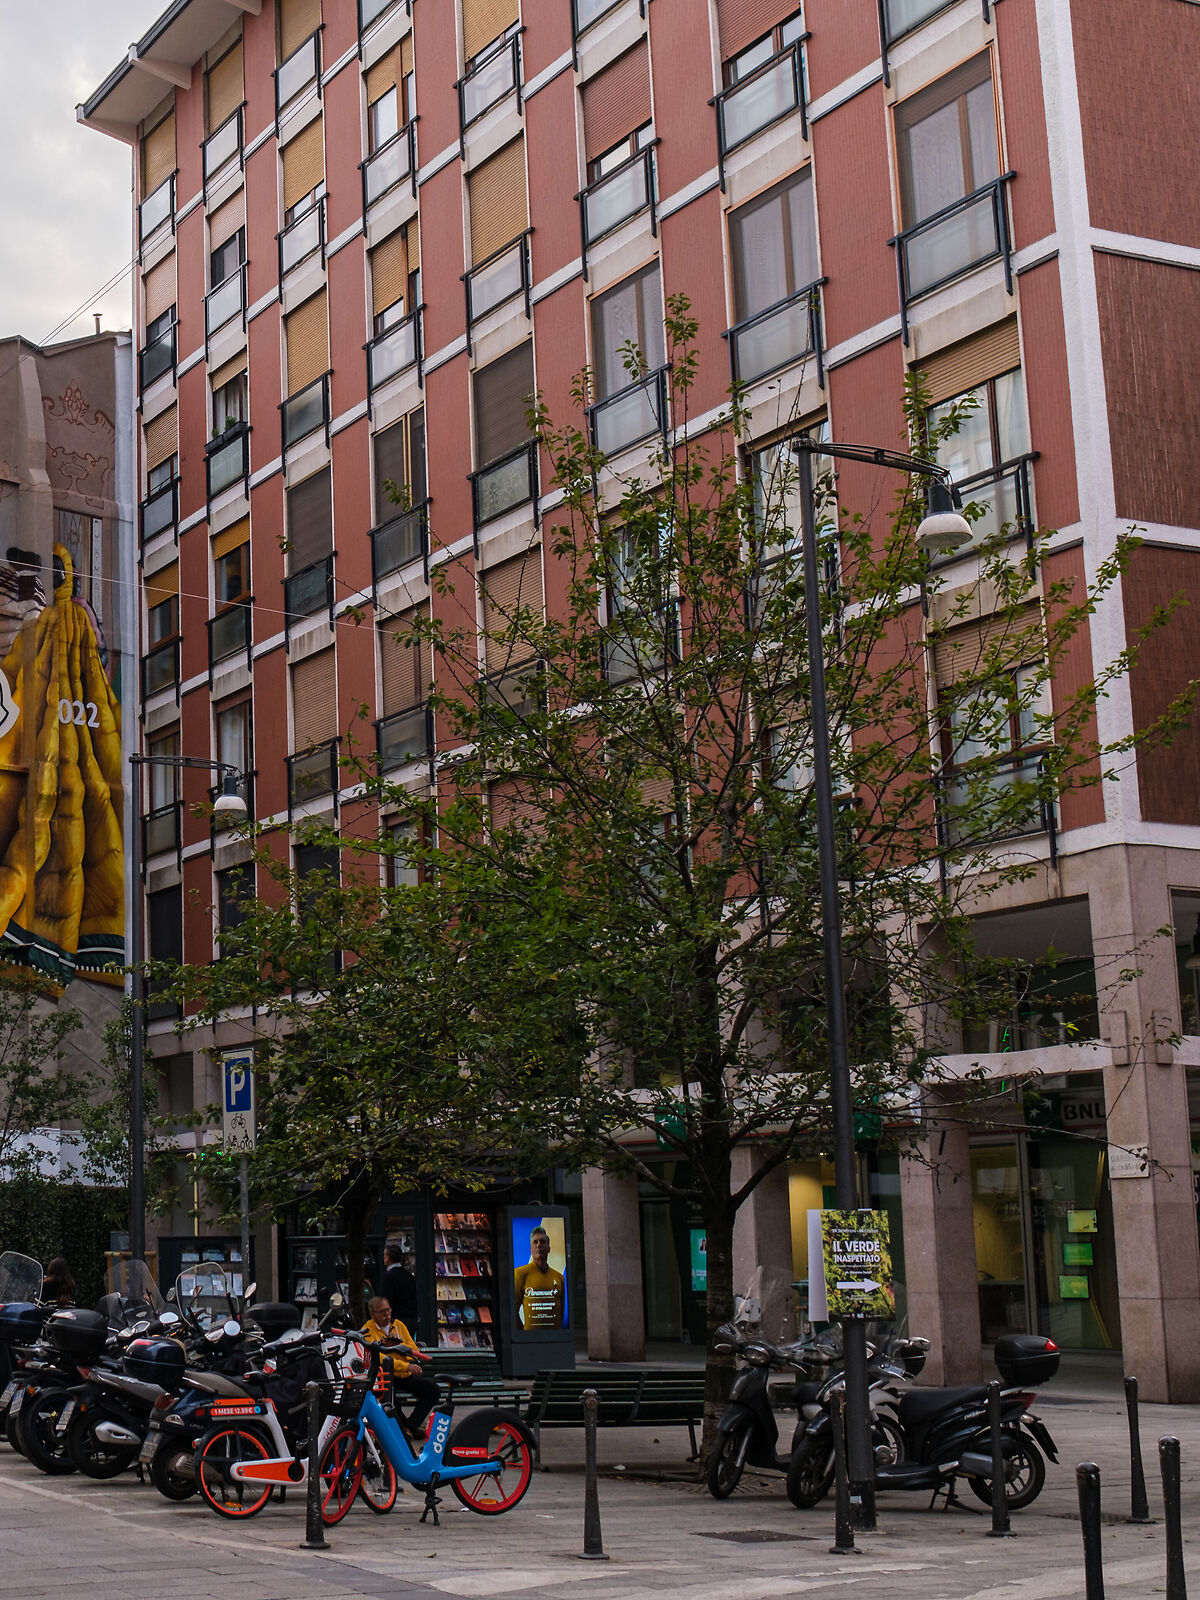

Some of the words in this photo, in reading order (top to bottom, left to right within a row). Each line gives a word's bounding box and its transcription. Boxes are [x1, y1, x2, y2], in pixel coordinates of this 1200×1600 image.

[58, 698, 100, 728] 022
[230, 1063, 246, 1106] P
[1064, 1102, 1106, 1120] BNL
[832, 1241, 842, 1252] IL
[844, 1241, 880, 1252] VERDE
[432, 1418, 450, 1454] dott
